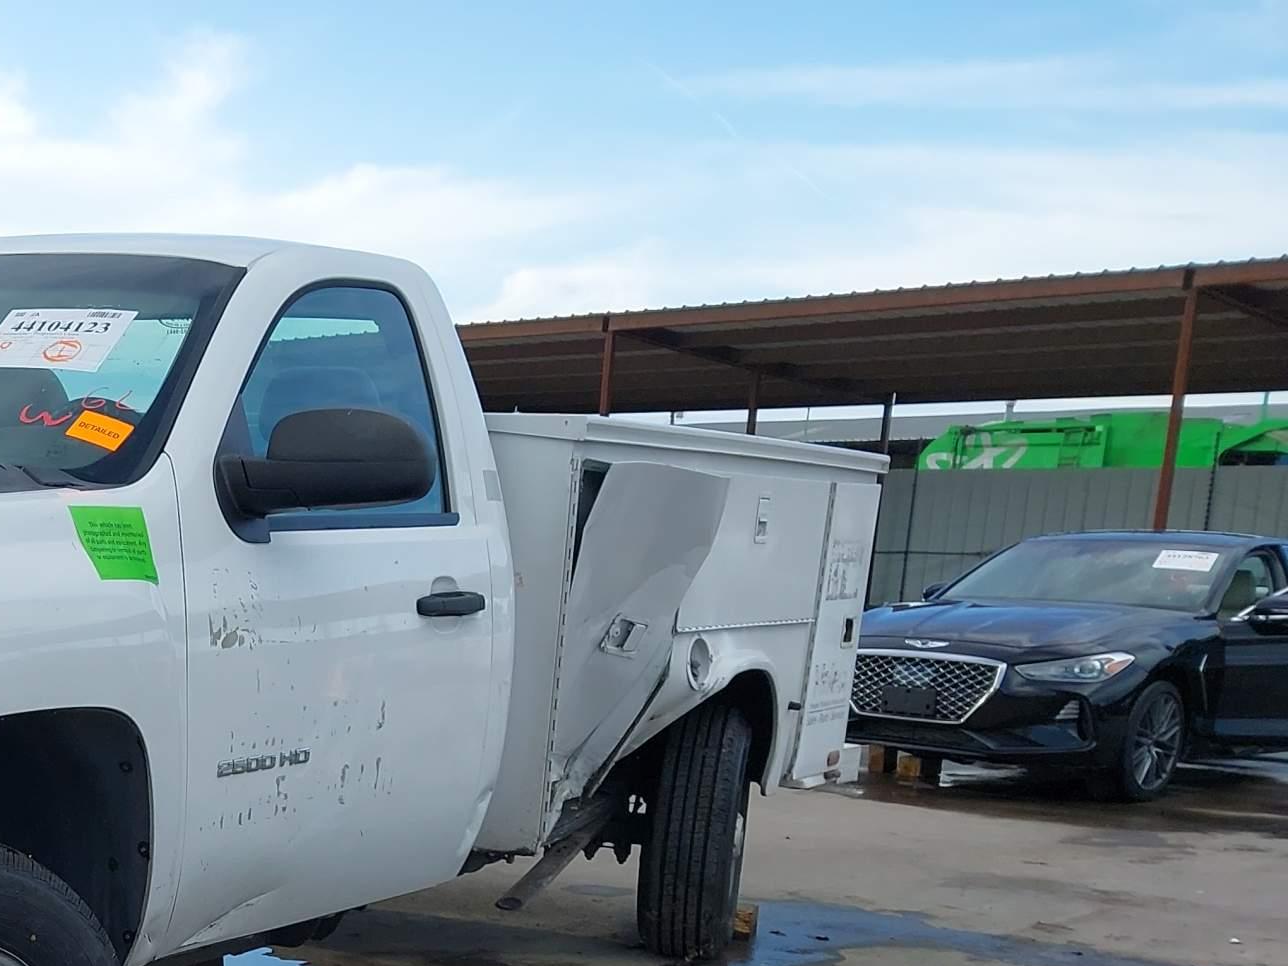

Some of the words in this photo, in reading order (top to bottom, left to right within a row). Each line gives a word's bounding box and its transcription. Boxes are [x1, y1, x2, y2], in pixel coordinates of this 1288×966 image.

[11, 320, 111, 333] 44104123
[78, 420, 120, 440] DETAILED
[216, 754, 277, 778] 2500
[279, 747, 311, 767] HD
